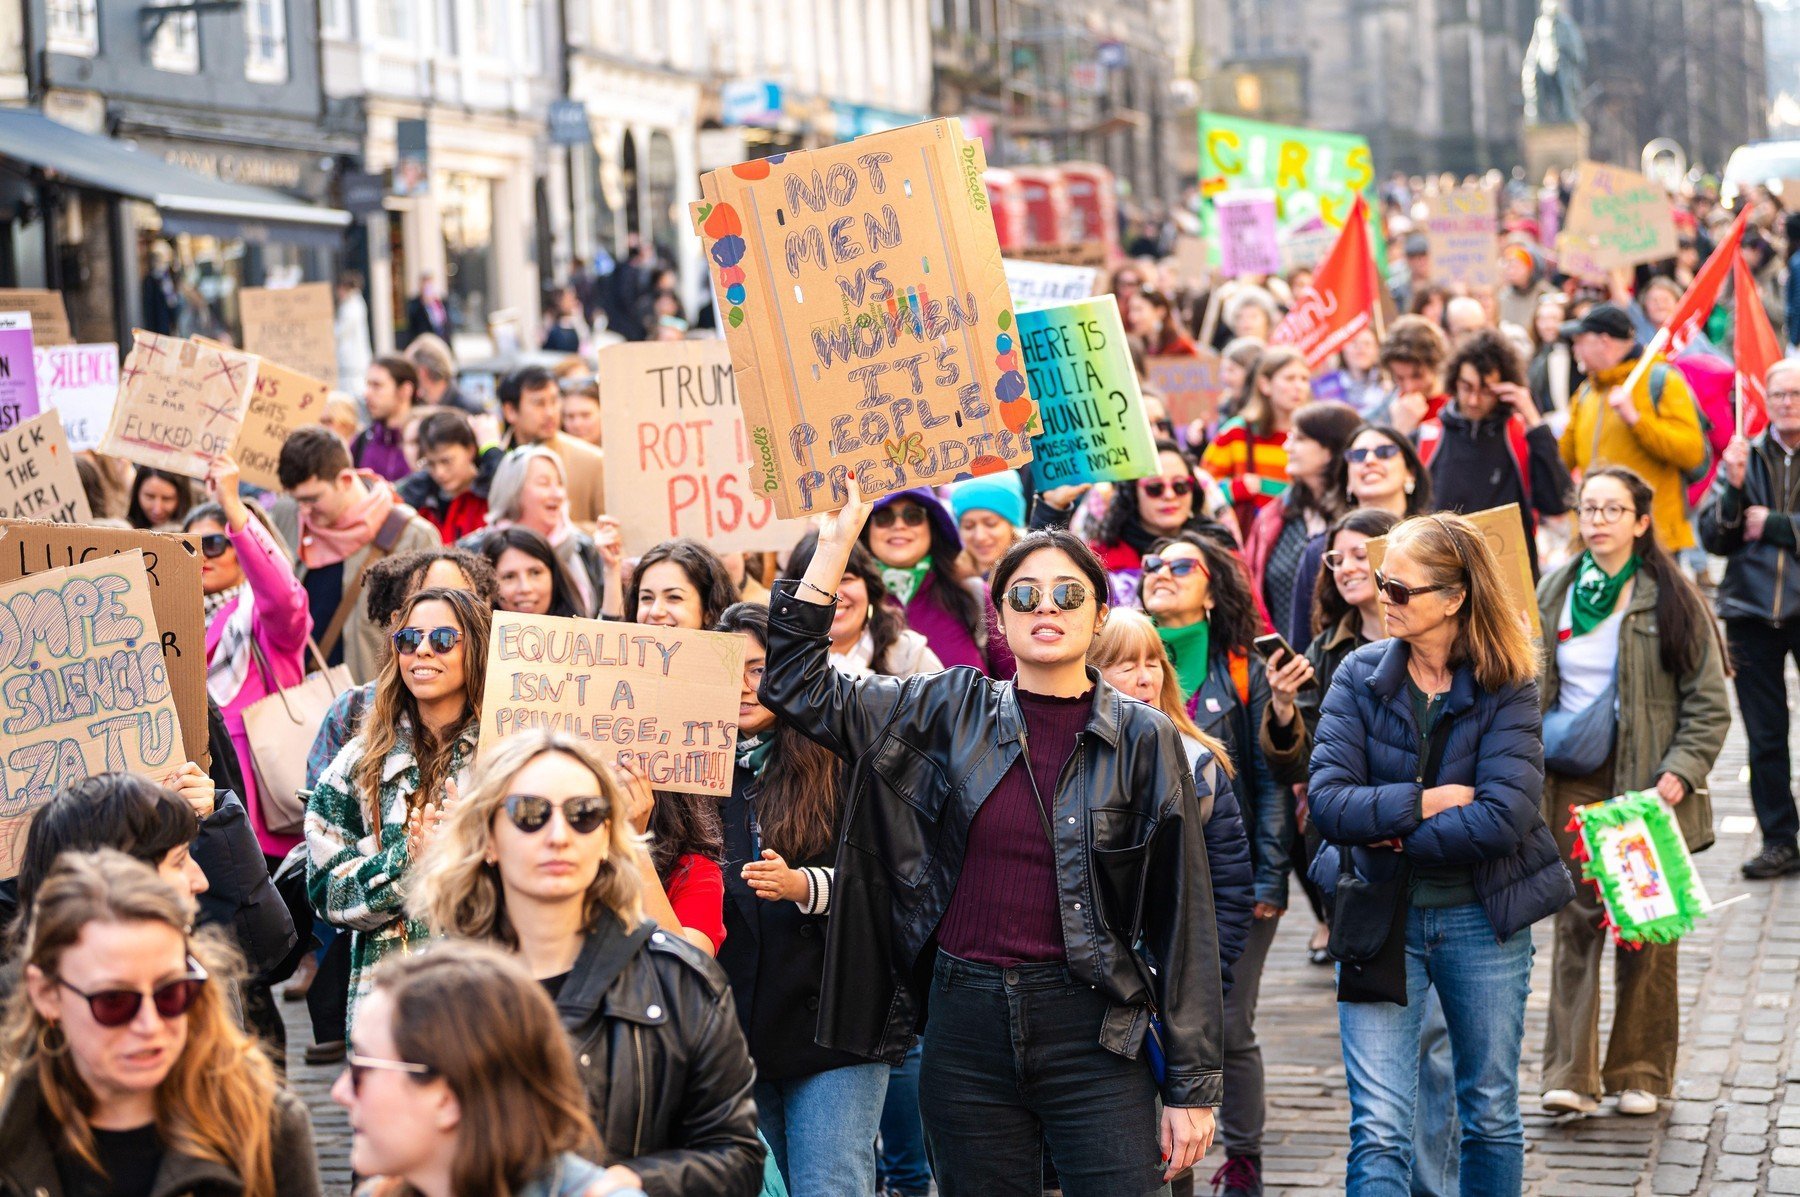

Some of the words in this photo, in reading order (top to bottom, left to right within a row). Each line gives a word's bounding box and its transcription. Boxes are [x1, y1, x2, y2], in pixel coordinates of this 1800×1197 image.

[784, 152, 893, 218] NOT
[962, 145, 988, 212] Driscoll's
[785, 204, 903, 279] MEN
[835, 260, 894, 308] VS
[810, 292, 979, 369] WOMEN
[1021, 322, 1076, 364] HERE
[1078, 320, 1106, 352] IS
[49, 350, 116, 388] SILENCE
[645, 364, 737, 409] TRUM
[1027, 360, 1103, 401] JULIA
[0, 426, 45, 463] UCK
[123, 414, 193, 448] FUCKED
[637, 420, 713, 471] ROT
[735, 419, 753, 464] I
[788, 382, 992, 466] PEOPLE
[1035, 436, 1089, 461] MISSING
[1091, 432, 1107, 447] IN
[754, 426, 779, 492] Driscoll's
[884, 432, 927, 466] VS
[1043, 457, 1080, 480] CHILE
[5, 458, 39, 489] THE
[498, 622, 683, 676] EQUALITY
[2, 643, 172, 735] SILENCIO
[510, 672, 591, 706] ISN'T
[611, 679, 635, 711] A
[682, 719, 739, 750] IT'S
[0, 738, 89, 817] LZA
[87, 707, 173, 773] TU
